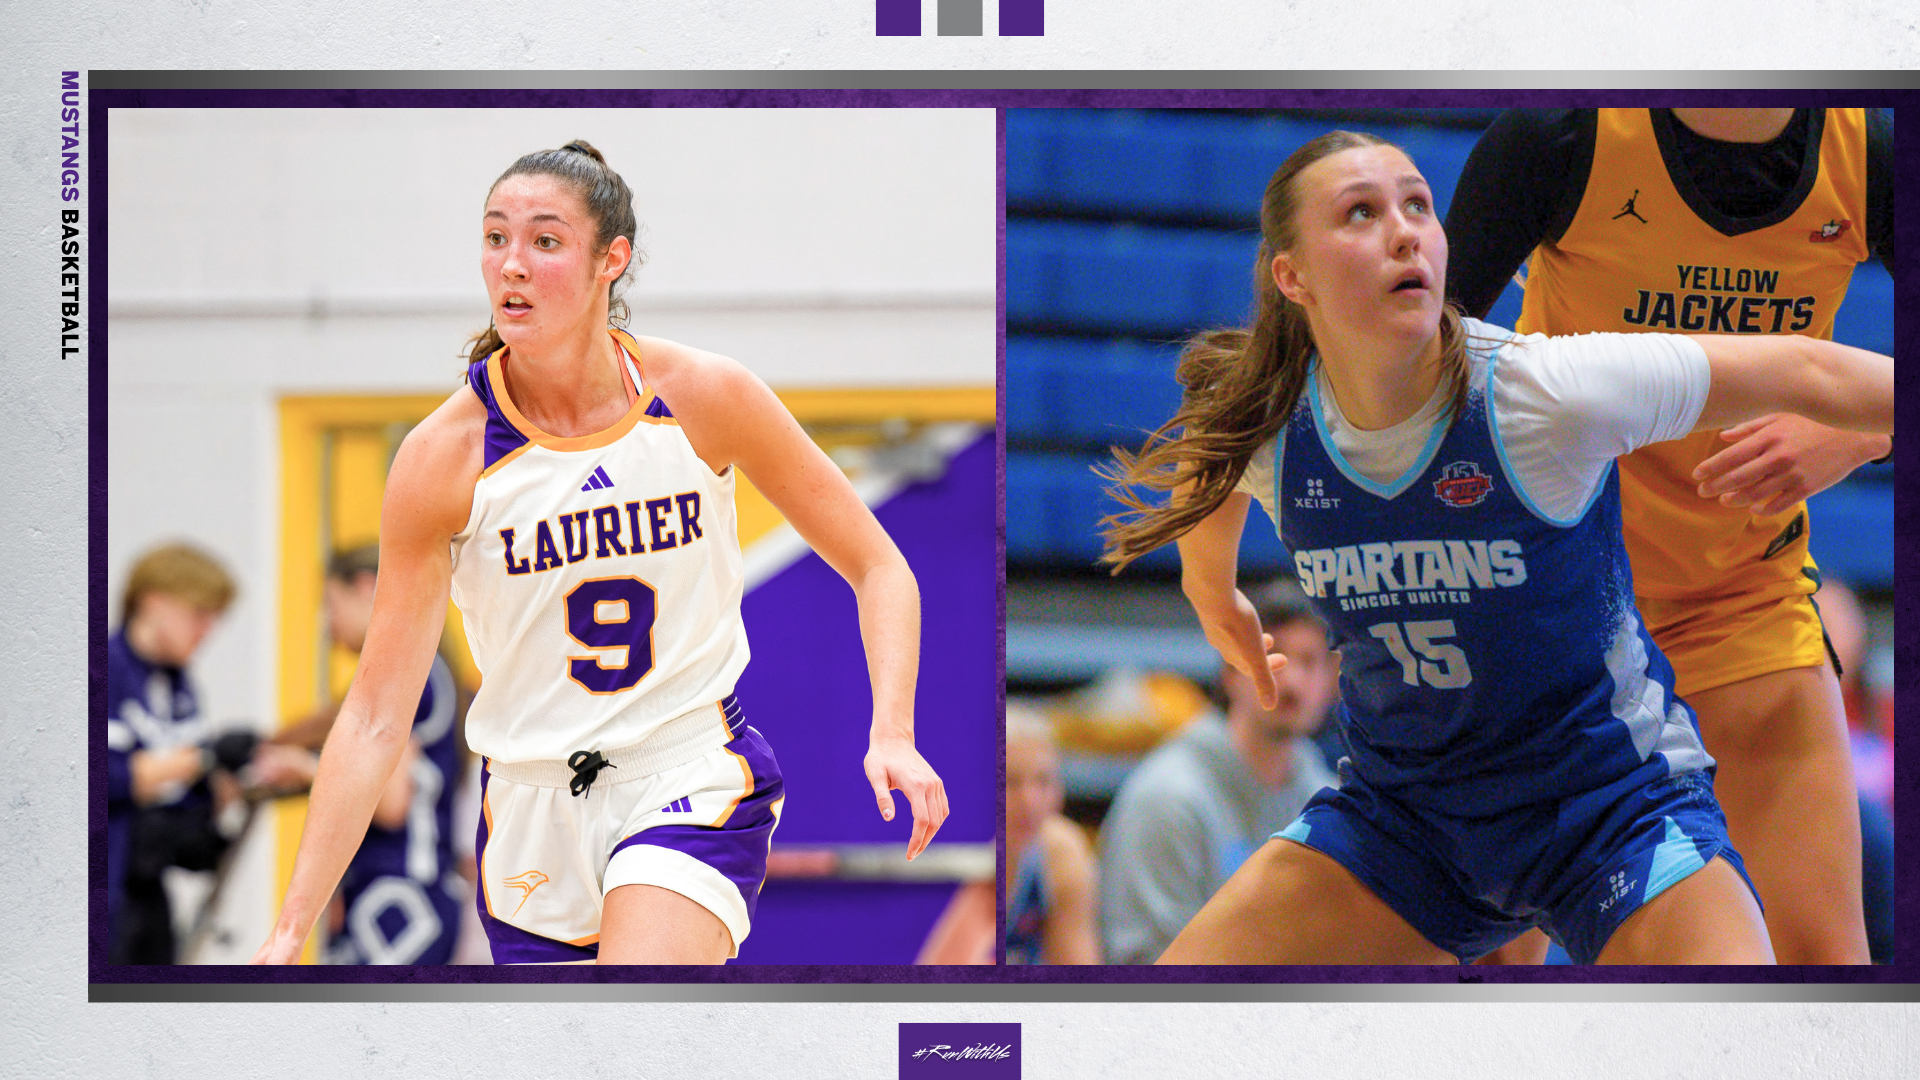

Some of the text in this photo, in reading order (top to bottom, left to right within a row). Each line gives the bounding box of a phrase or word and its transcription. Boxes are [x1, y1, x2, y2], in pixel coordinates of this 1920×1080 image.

[1677, 264, 1779, 294] YELLOW
[1623, 289, 1816, 333] JACKETS
[1294, 497, 1341, 509] XEIST
[498, 490, 703, 576] LAURIER
[1294, 539, 1528, 598] SPARTANS
[1340, 591, 1471, 612] SIMCOE UNITED
[562, 574, 658, 695] 9
[1367, 619, 1473, 689] 15
[1599, 879, 1637, 912] XEIST
